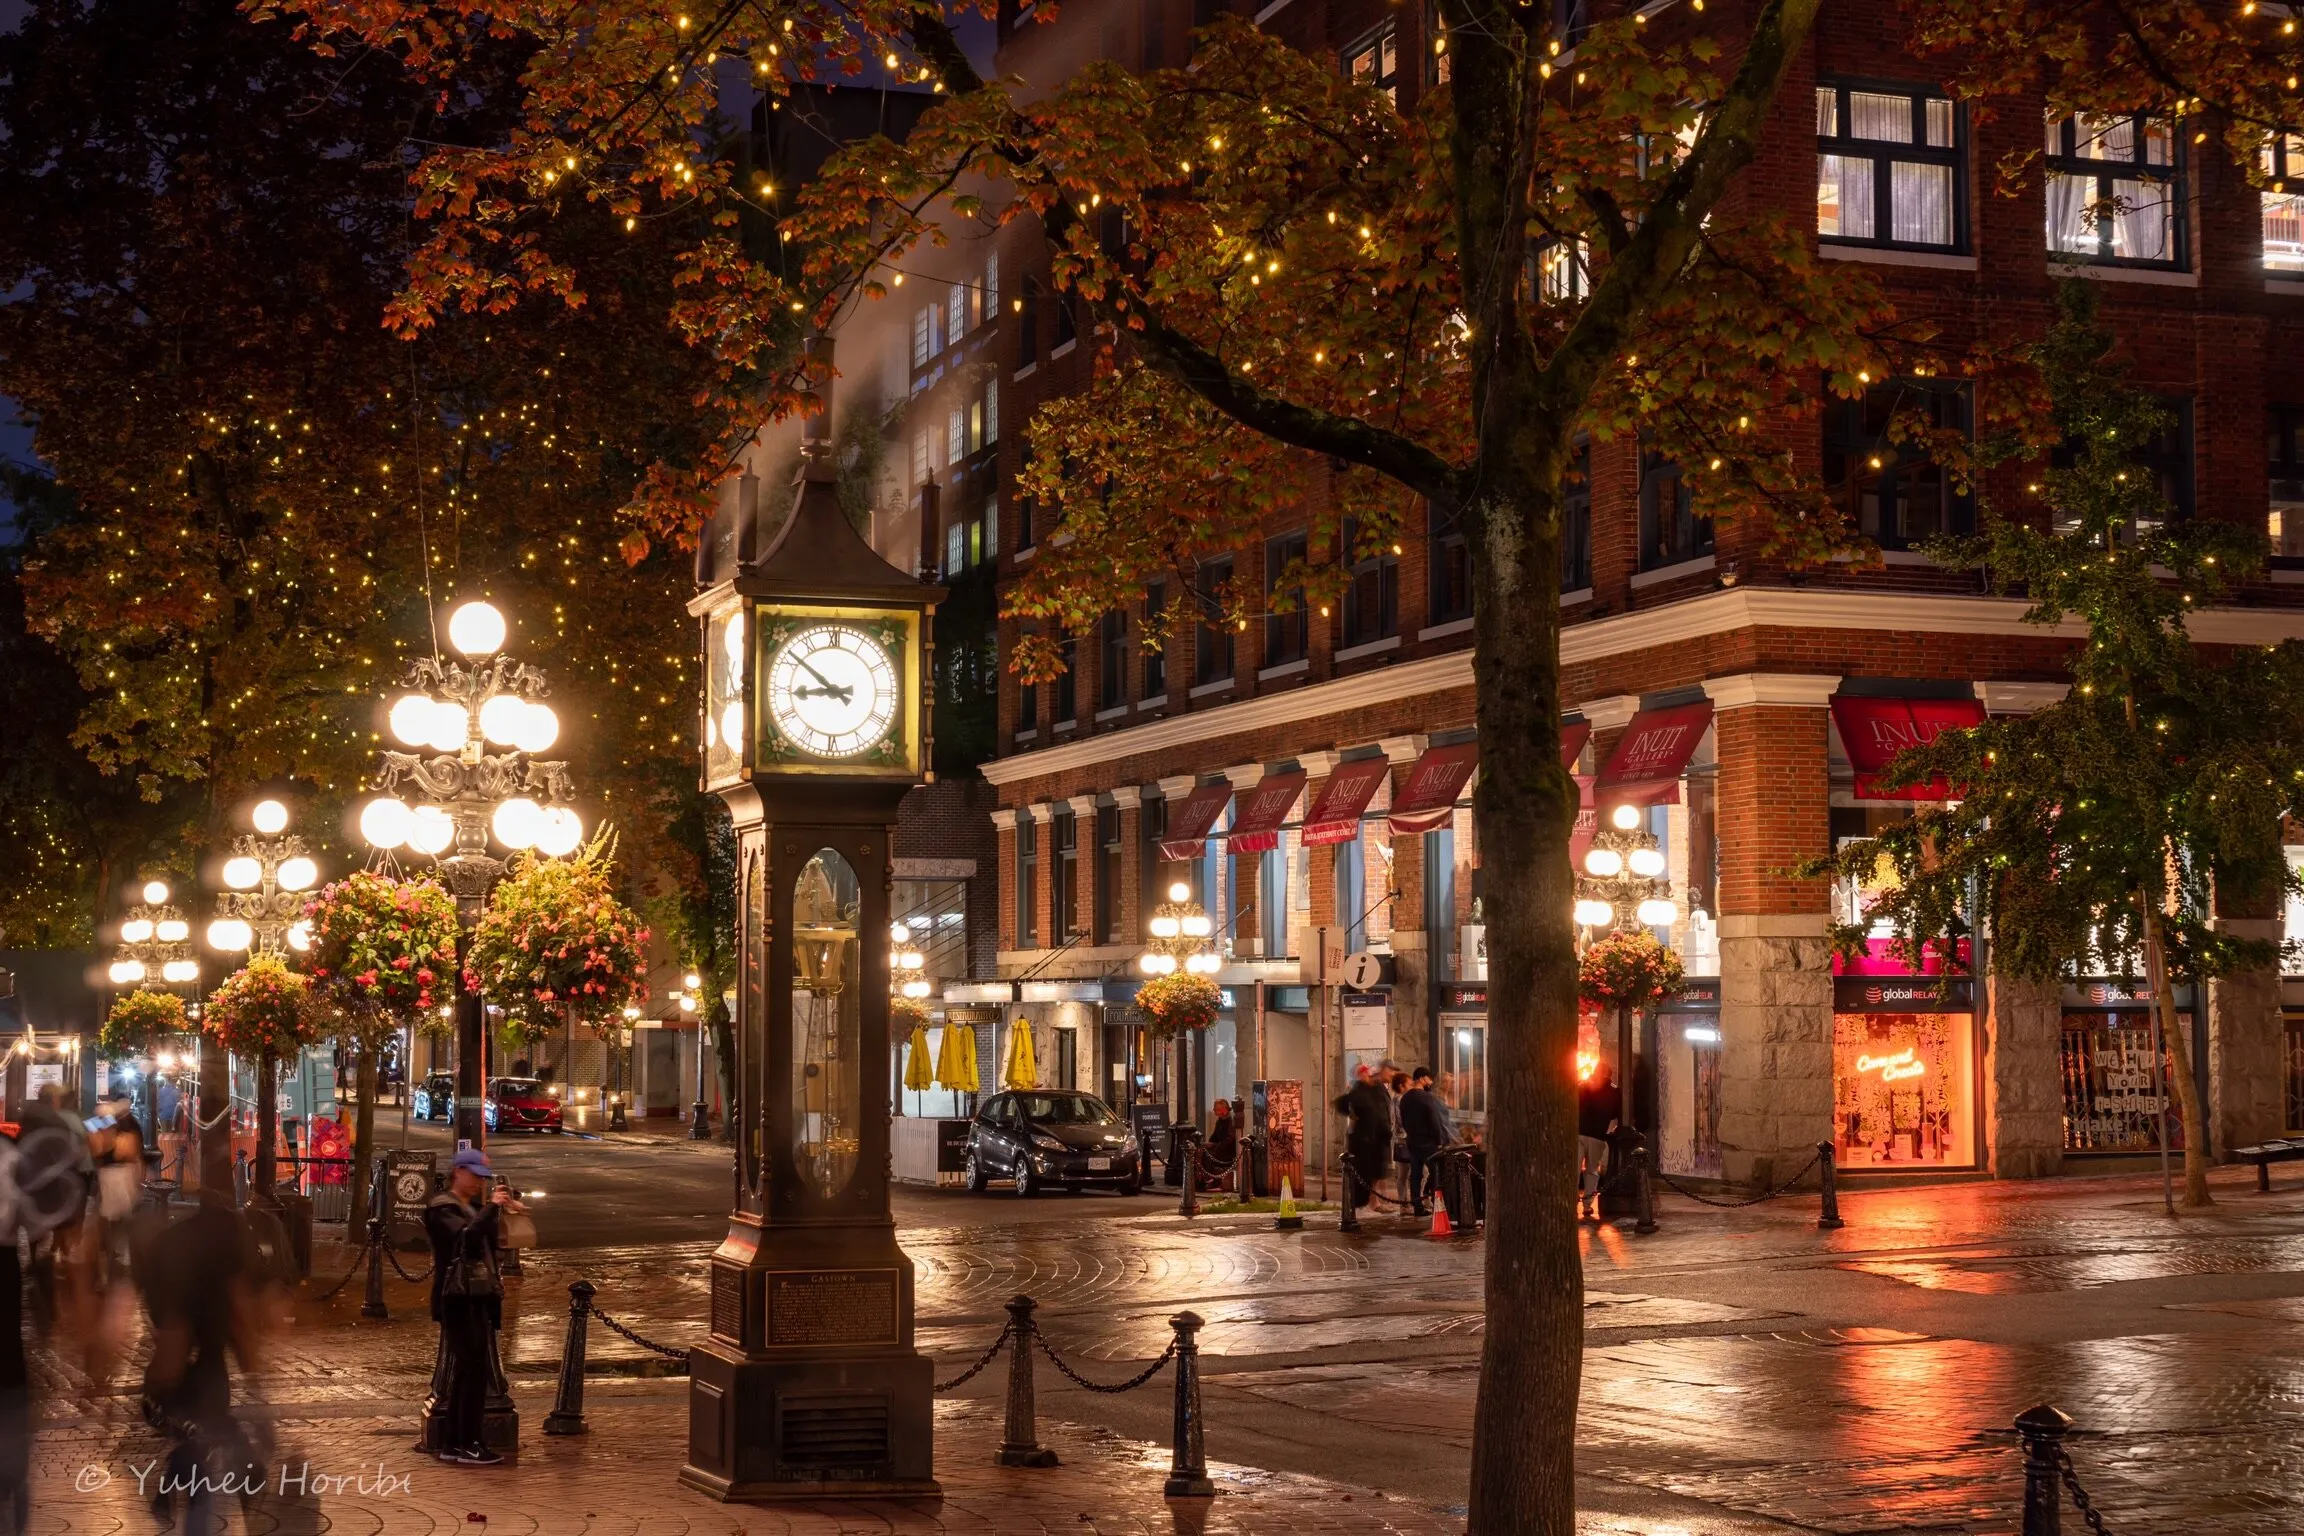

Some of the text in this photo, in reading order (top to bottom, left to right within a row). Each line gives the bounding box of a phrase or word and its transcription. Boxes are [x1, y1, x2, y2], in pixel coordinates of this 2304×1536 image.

[1627, 725, 1688, 755] INUIT
[1870, 720, 1950, 743] INU
[1627, 750, 1670, 763] GALLERY
[1417, 760, 1464, 786] INUIT
[1253, 787, 1291, 810] INUIT
[1329, 775, 1371, 799] INUIT
[1184, 799, 1218, 819] INUIT
[1575, 809, 1595, 823] UIT
[811, 1274, 856, 1283] GASTOWN
